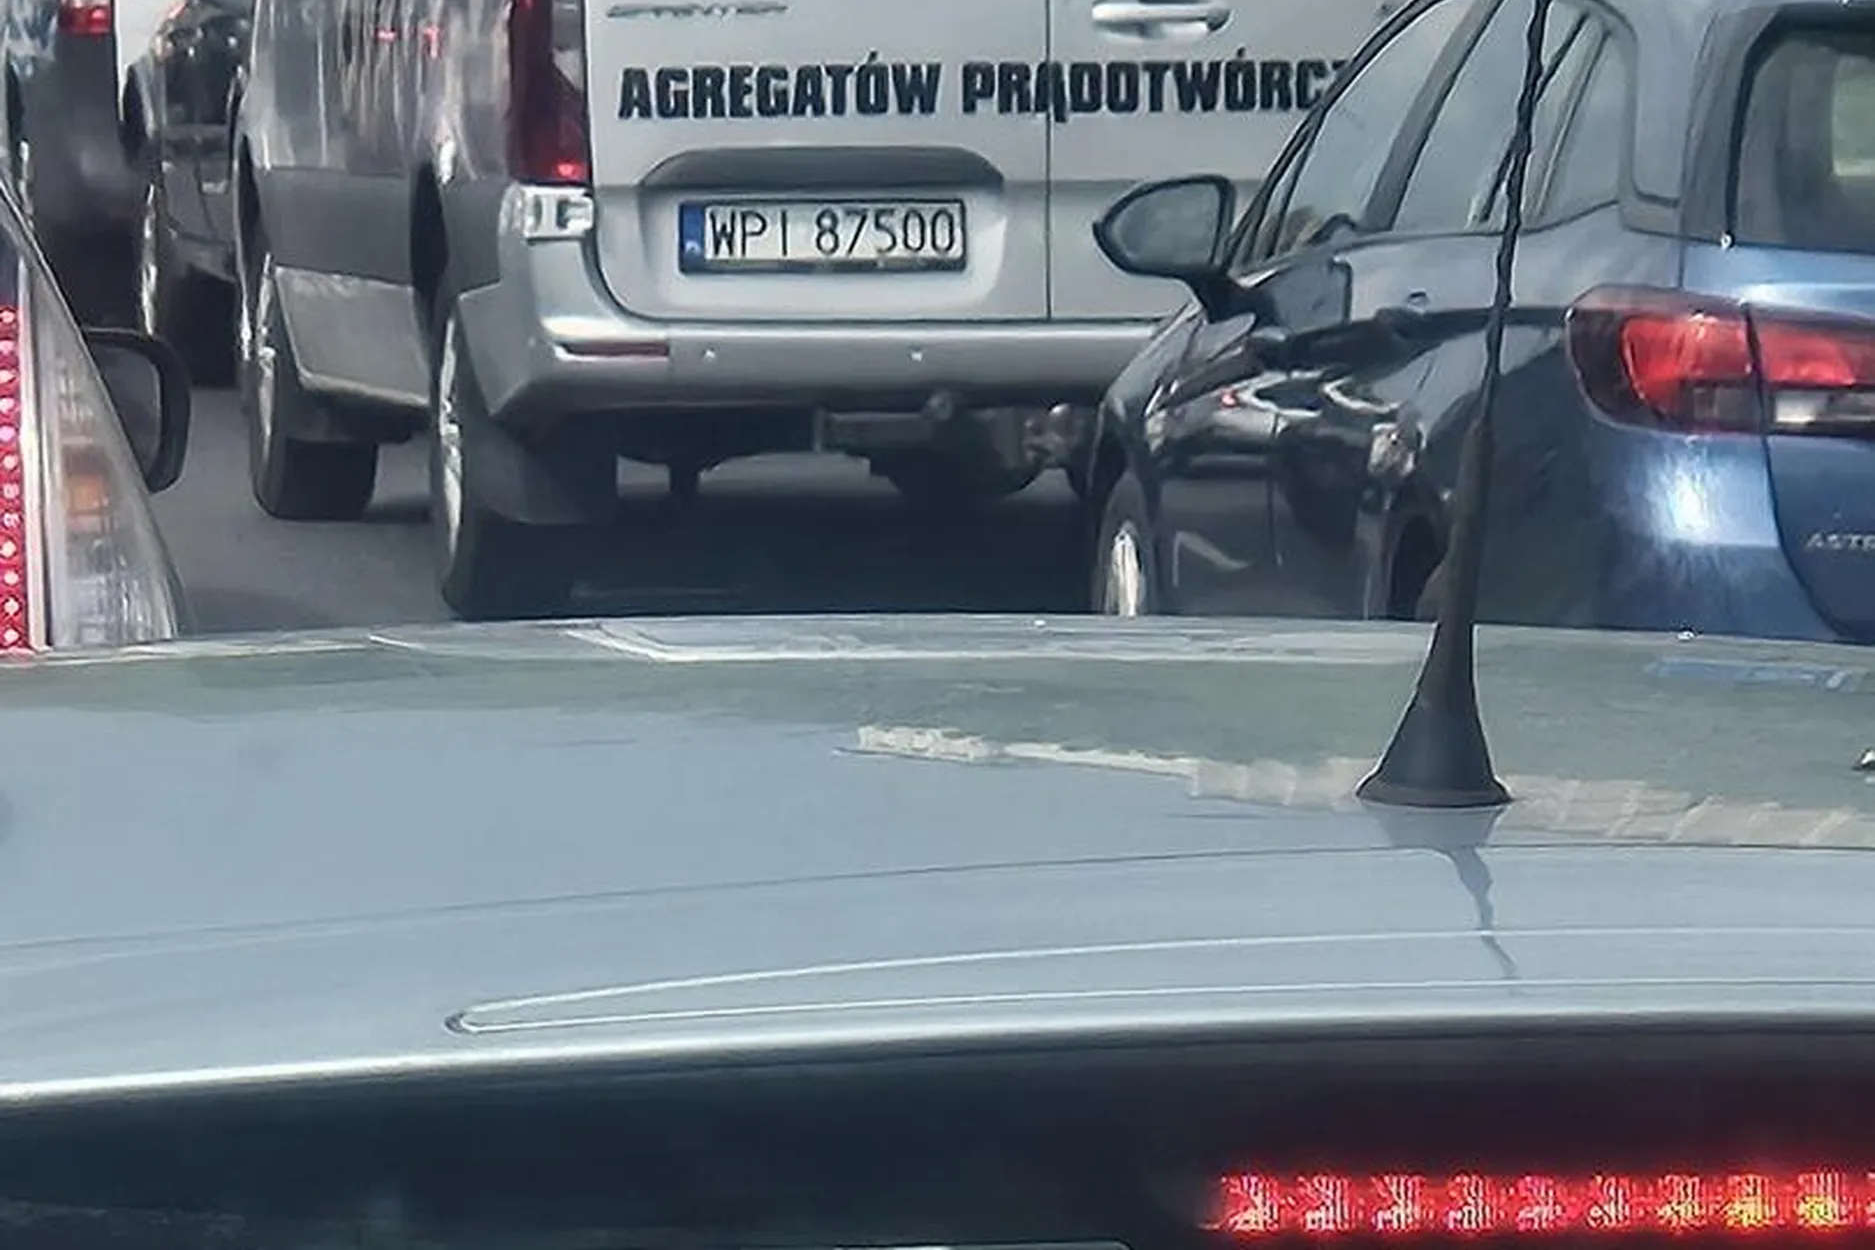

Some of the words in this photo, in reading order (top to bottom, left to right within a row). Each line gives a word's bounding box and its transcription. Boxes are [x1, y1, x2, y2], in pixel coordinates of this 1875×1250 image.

[618, 51, 942, 119] AGREGATÓW
[962, 47, 1349, 124] PRĄDOTWÓRC
[815, 208, 955, 255] 87500
